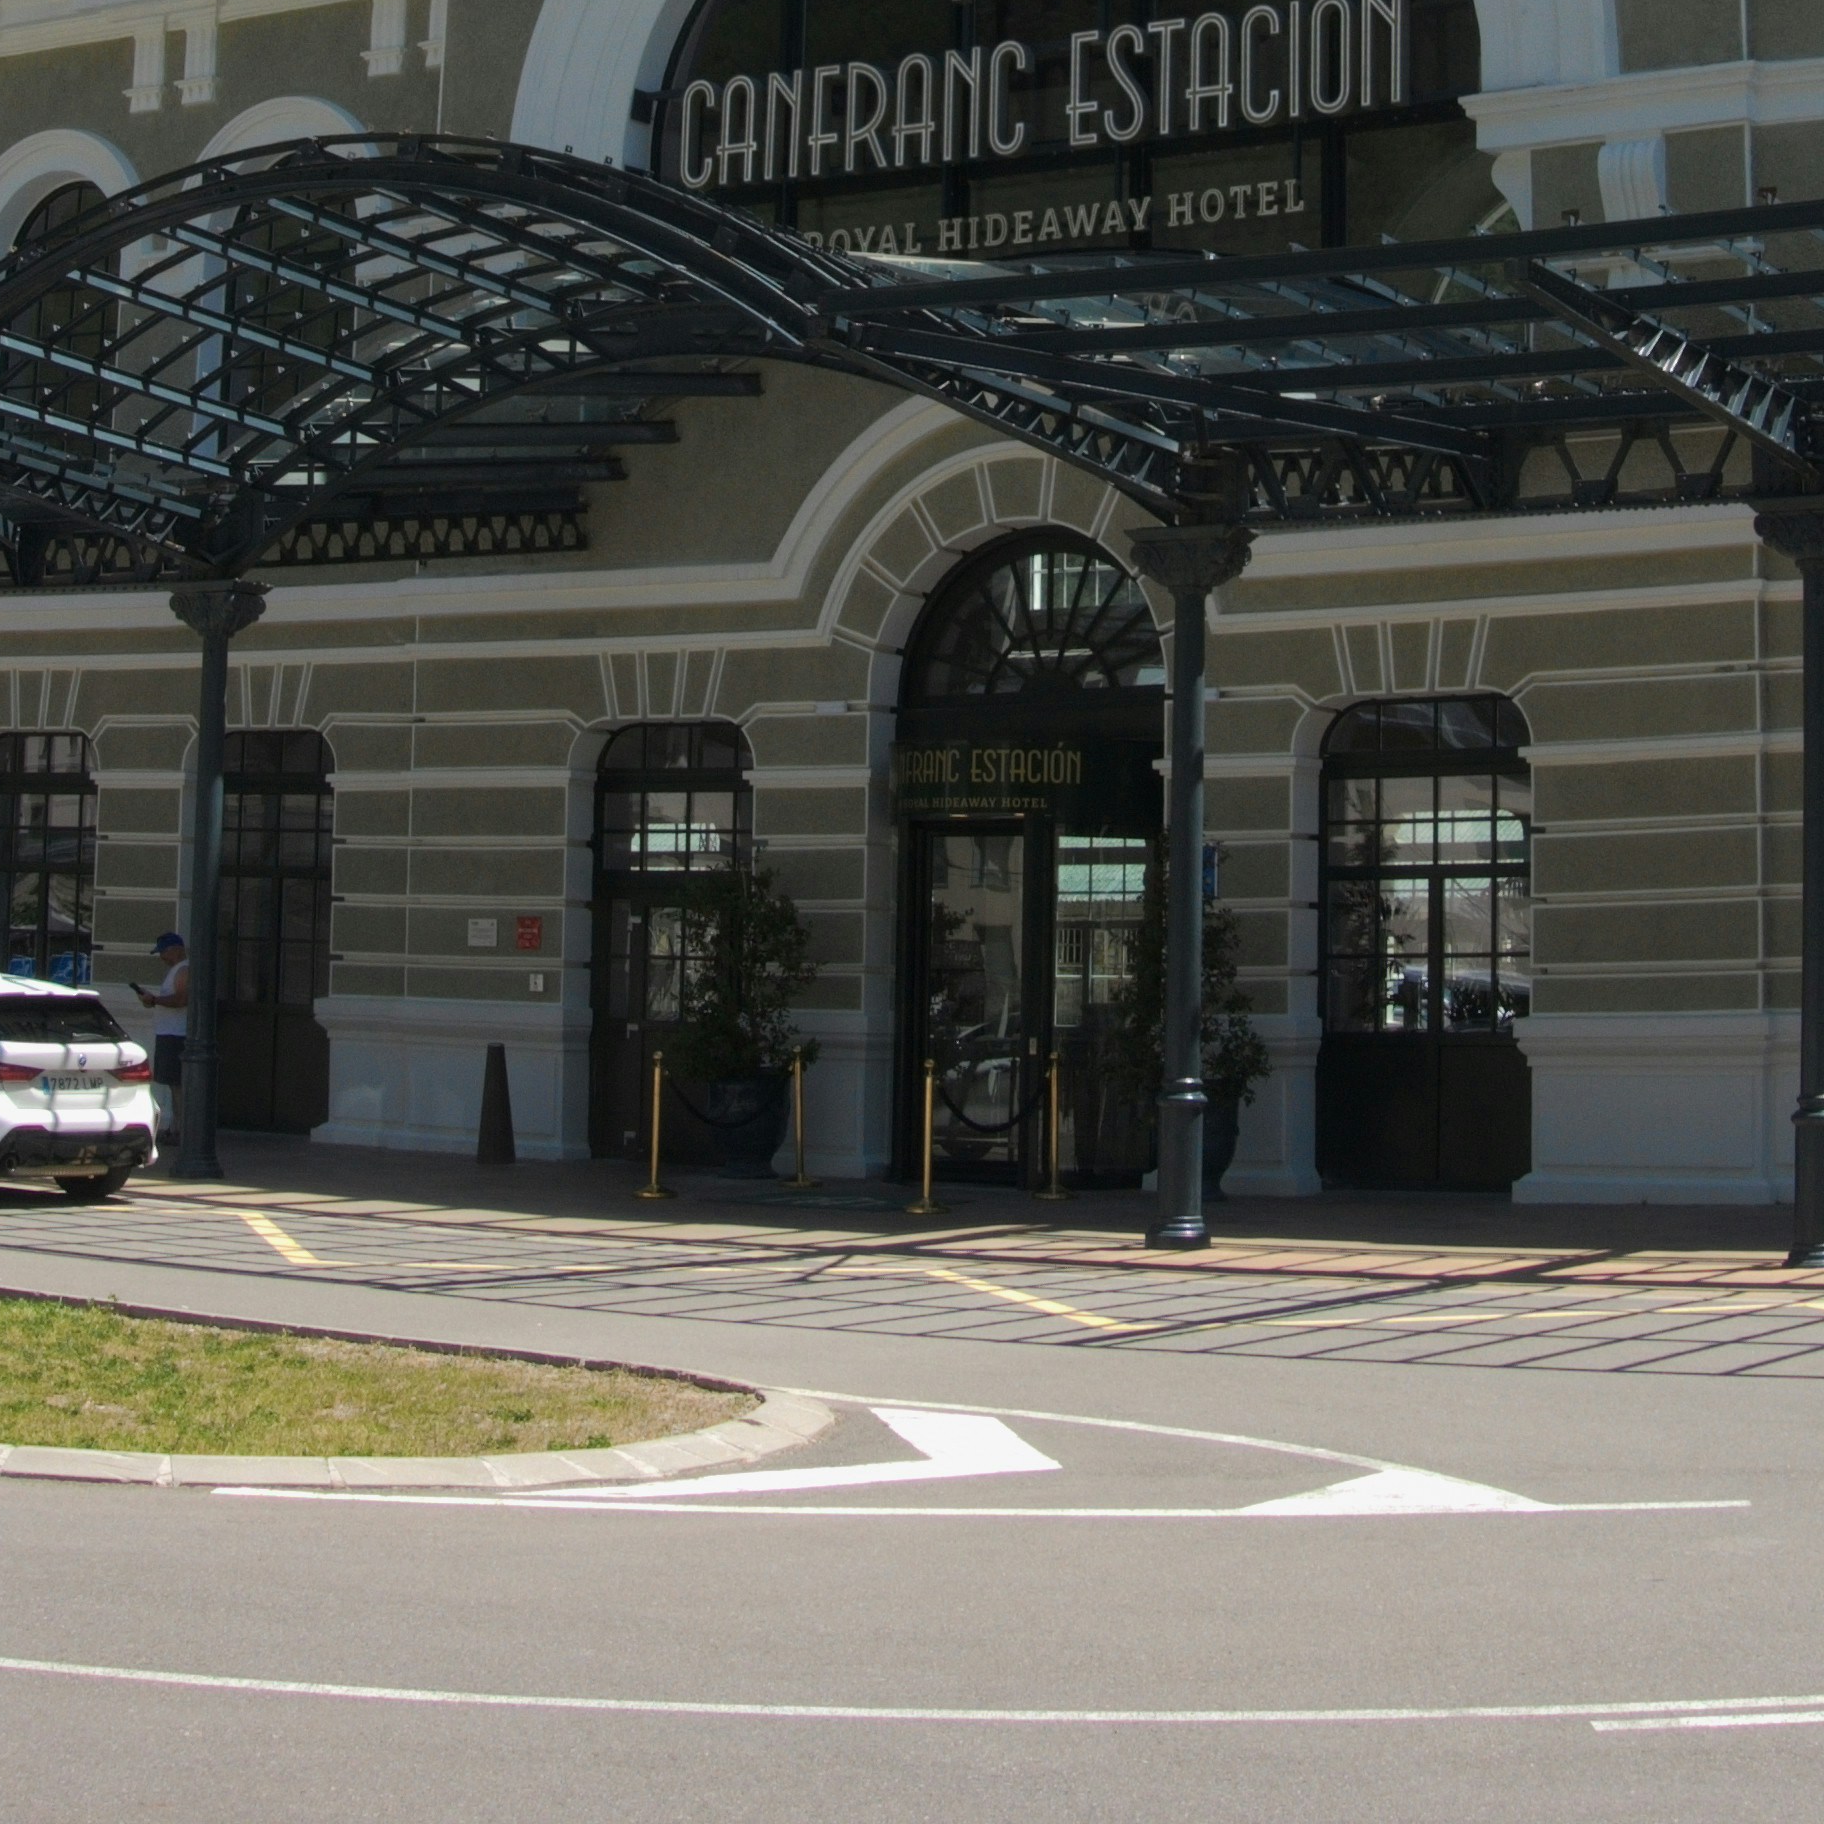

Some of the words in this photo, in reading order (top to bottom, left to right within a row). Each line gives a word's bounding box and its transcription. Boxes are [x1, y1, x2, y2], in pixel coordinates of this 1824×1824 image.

[680, 40, 1028, 189] CANFRANC
[938, 196, 1151, 251] HIDEAWAY
[1167, 179, 1306, 228] HOTEL
[971, 742, 1081, 784] ESTACIÓN
[932, 797, 996, 808] HIDEAWAY
[1001, 798, 1048, 808] HOTEL
[50, 1077, 79, 1090] 7872
